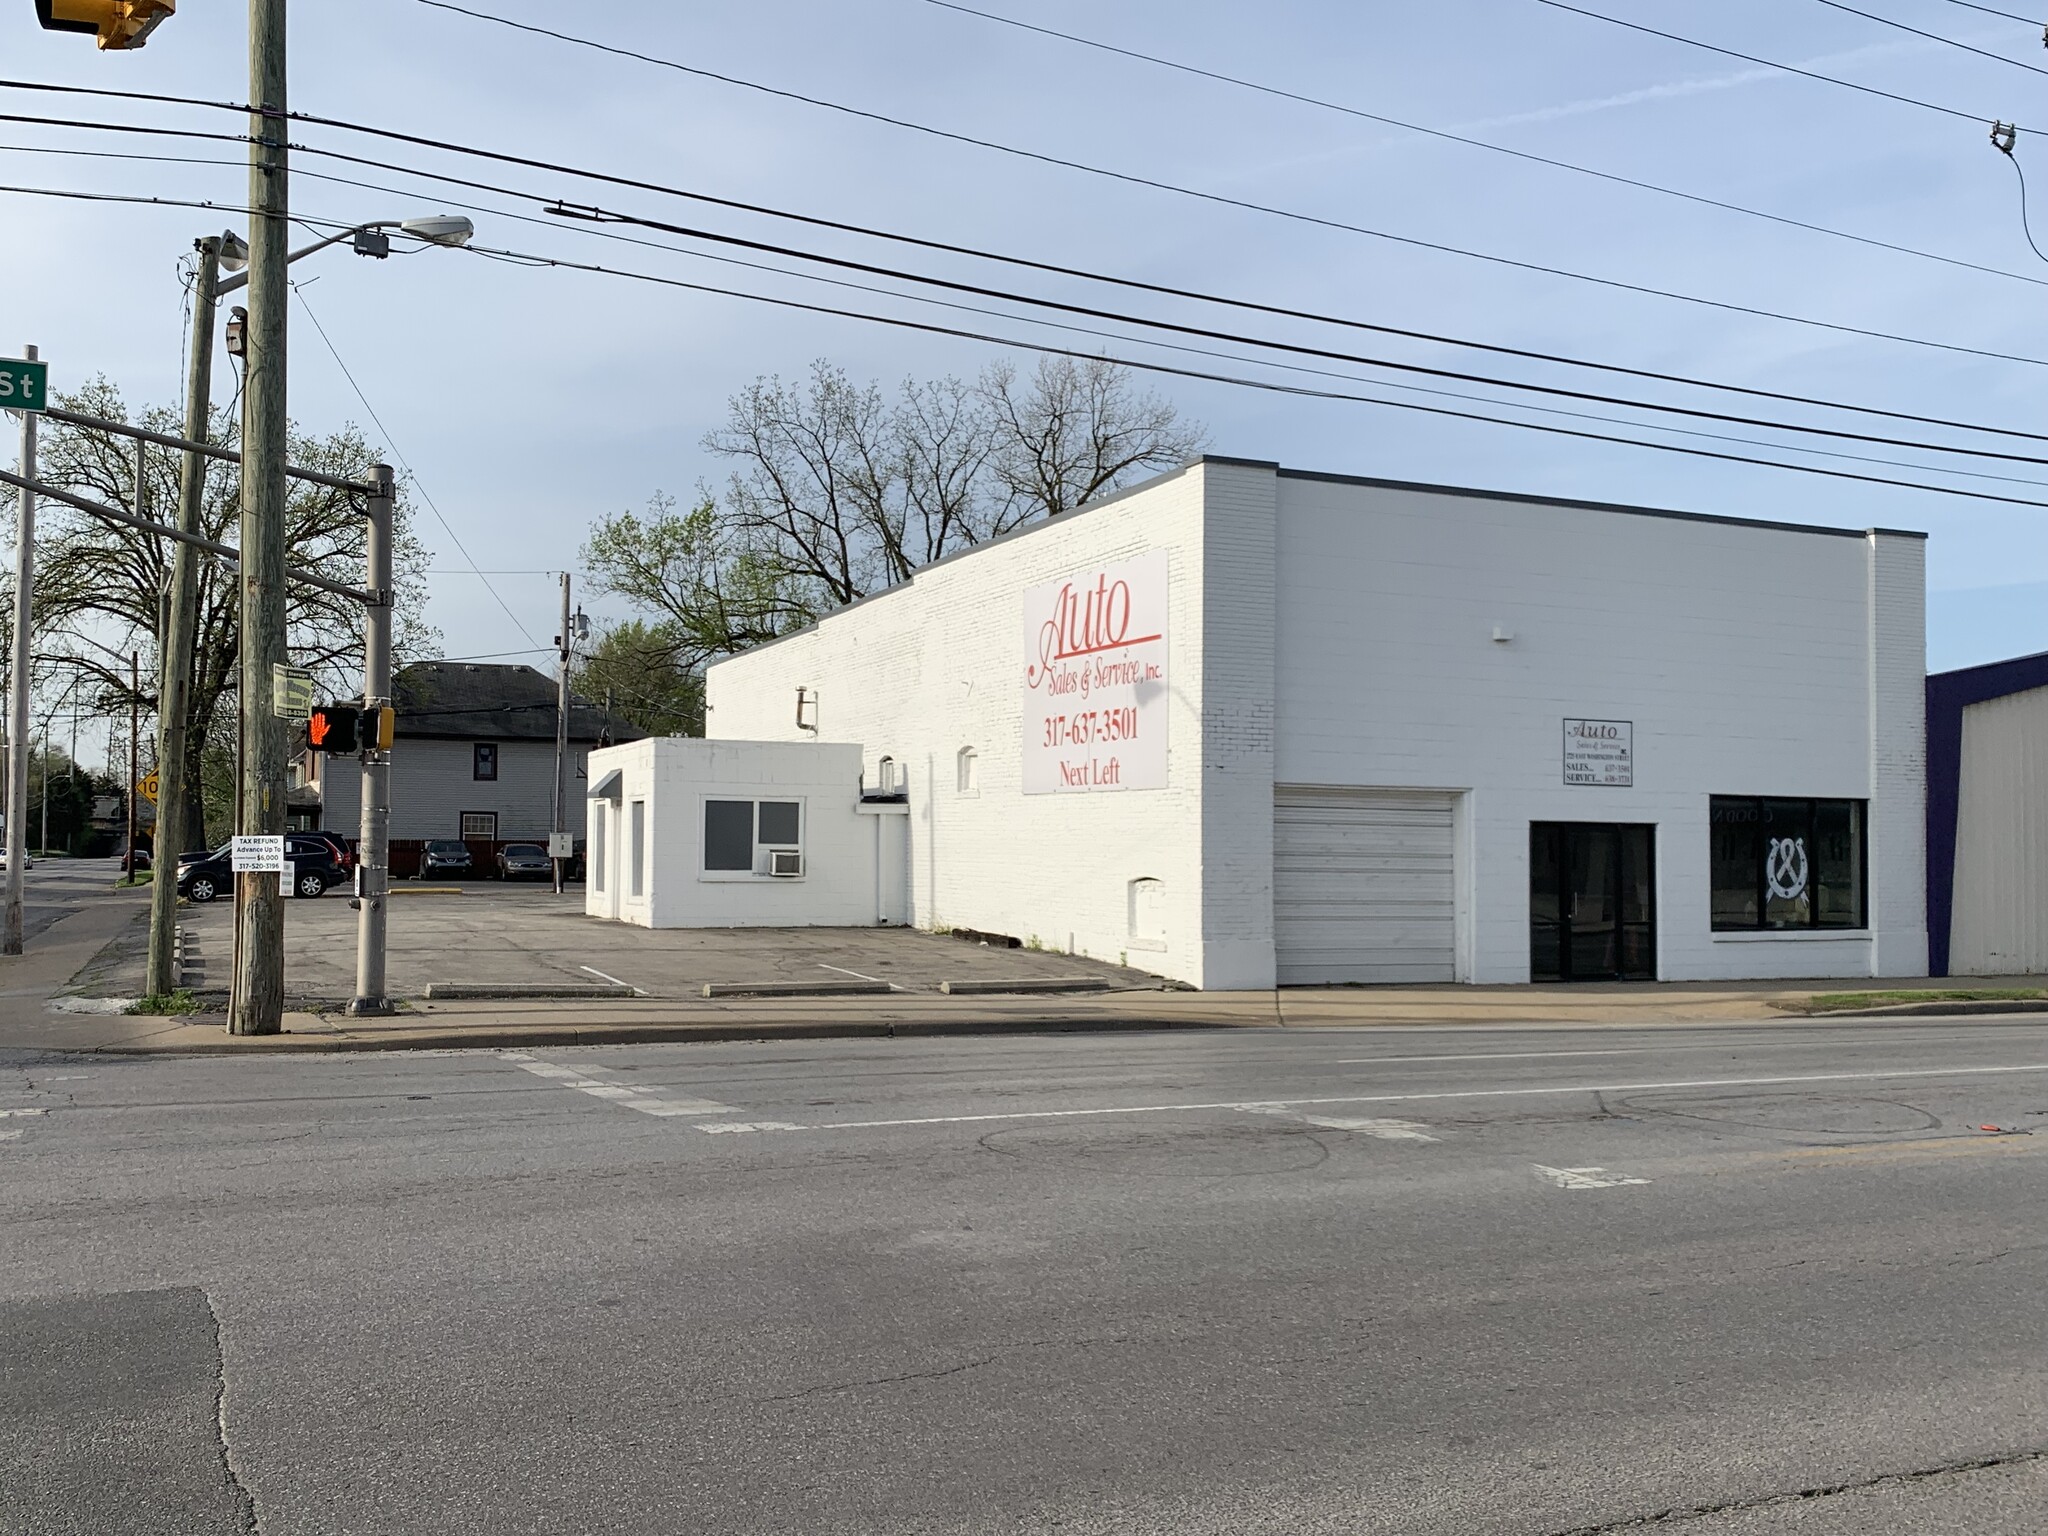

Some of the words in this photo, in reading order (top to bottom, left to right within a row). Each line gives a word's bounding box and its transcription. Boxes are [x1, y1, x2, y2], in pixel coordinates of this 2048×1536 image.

[0, 371, 34, 398] St
[1028, 573, 1134, 688] Auto
[1048, 661, 1078, 697] Sales
[1081, 660, 1092, 700] &
[1145, 663, 1163, 680] Inc.
[1043, 706, 1139, 748] 317-637-3501
[1567, 721, 1618, 739] Auto
[1059, 759, 1090, 787] Next
[1093, 757, 1121, 785] Left
